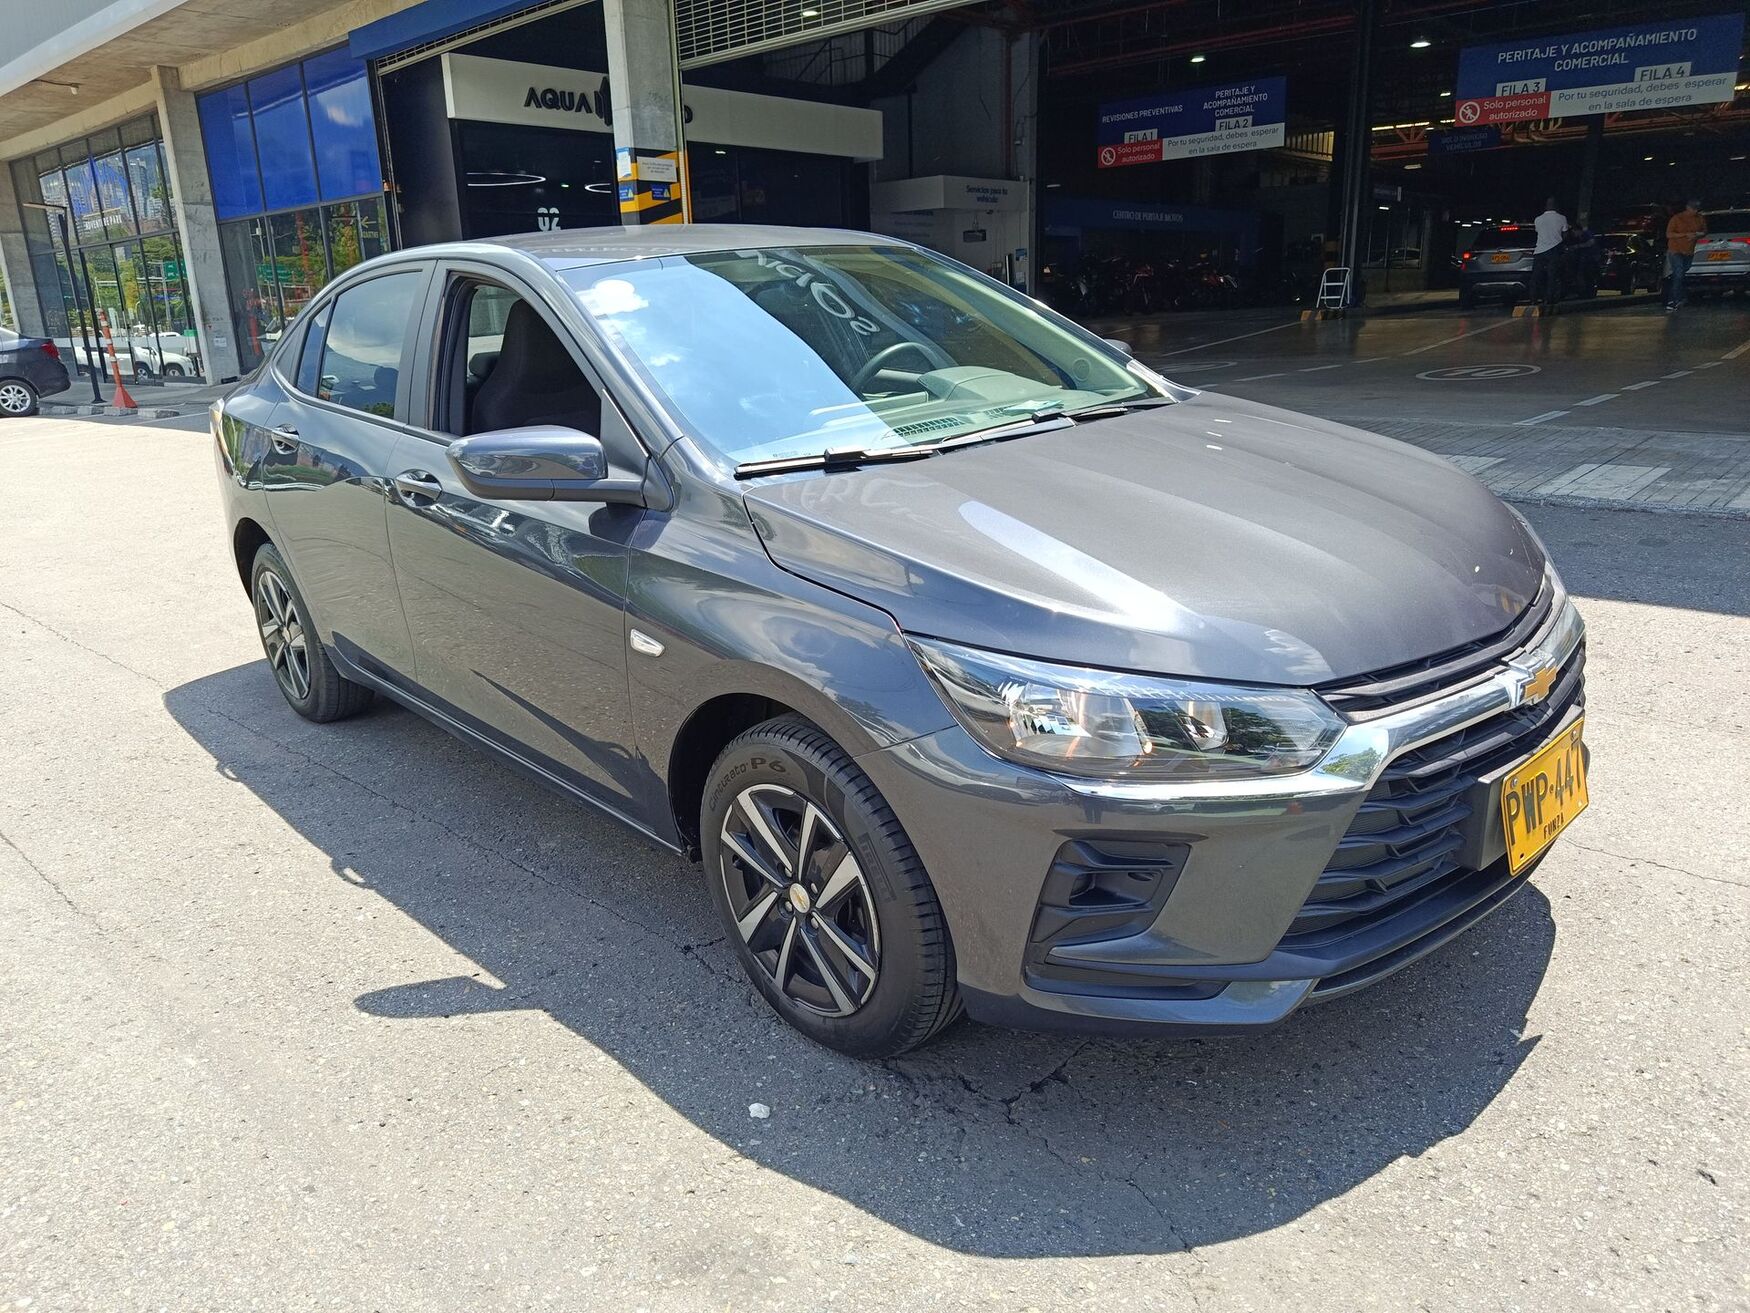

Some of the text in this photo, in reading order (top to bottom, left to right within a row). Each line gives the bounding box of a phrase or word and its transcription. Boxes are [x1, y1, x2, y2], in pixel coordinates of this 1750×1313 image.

[1498, 28, 1697, 64] PERITAJE Y ACOMPAÑAMIENTO
[1554, 52, 1629, 72] COMERCIAL
[1640, 66, 1685, 82] FILA 4
[1215, 84, 1256, 98] PERITAJE Y
[1501, 81, 1540, 96] FILA 3
[1558, 77, 1727, 101] Por tu seguridad, debes esperar
[523, 86, 593, 114] AQUA
[1483, 95, 1546, 110] Solo personal
[1588, 94, 1692, 112] en la sala de espera
[1102, 104, 1183, 123] REVISIONES PREVENTIVAS
[1215, 105, 1255, 117] COMERCIAL
[1488, 107, 1538, 121] autorizado
[1218, 118, 1249, 132] FILA 2
[1128, 132, 1148, 143] FILA
[750, 757, 786, 773] P6
[1543, 812, 1565, 840] FUNZA
